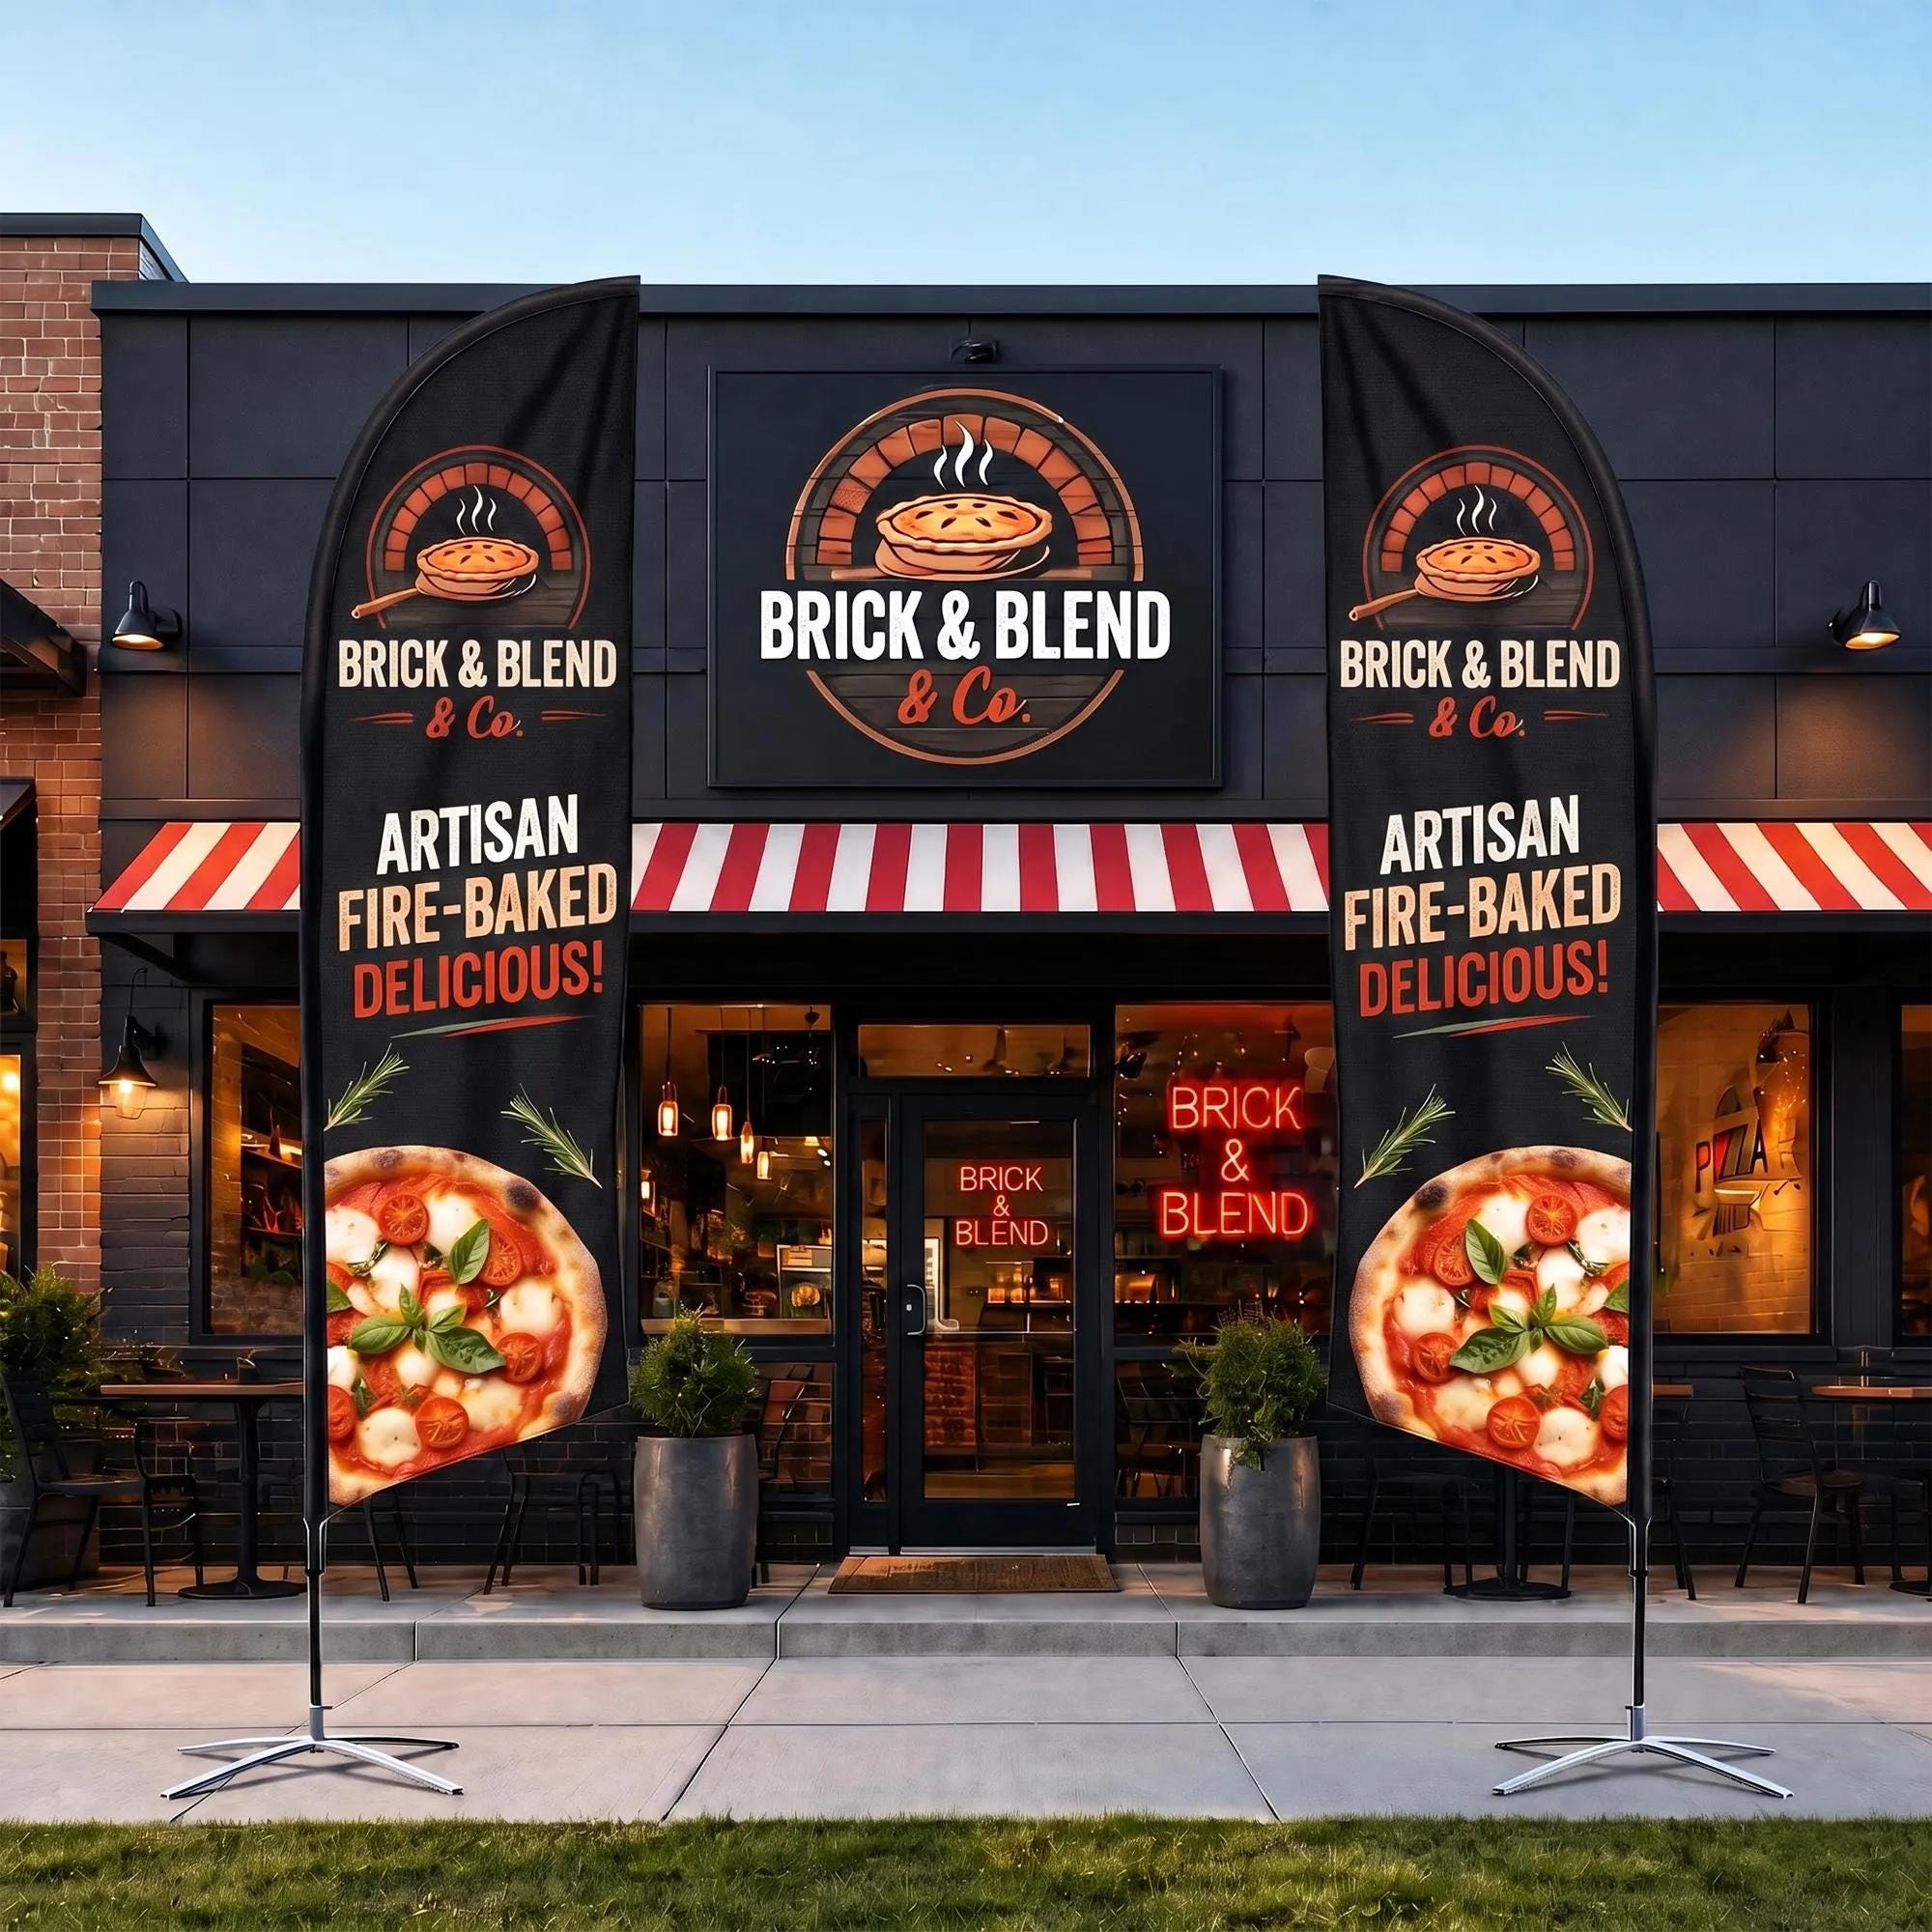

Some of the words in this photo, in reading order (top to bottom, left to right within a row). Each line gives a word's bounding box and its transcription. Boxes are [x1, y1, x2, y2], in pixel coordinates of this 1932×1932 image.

[760, 590, 924, 660] BRICK
[937, 589, 981, 661] &
[995, 590, 1171, 660] BLEND
[338, 639, 449, 688] BRICK
[458, 639, 487, 688] &
[497, 639, 617, 688] BLEND
[1340, 639, 1453, 688] BRICK
[1462, 639, 1492, 688] &
[1500, 639, 1621, 688] BLEND
[426, 696, 456, 739] &
[467, 696, 525, 739] Co.
[897, 668, 938, 724] &
[952, 666, 1031, 724] Co.
[1428, 696, 1459, 738] &
[1468, 696, 1525, 738] Co.
[376, 794, 579, 875] ARTISAN
[1379, 794, 1579, 875] ARTISAN
[338, 863, 617, 952] FIRE-BAKED
[1345, 863, 1622, 952] FIRE-BAKED
[354, 940, 603, 1018] DELICIOUS!
[1359, 939, 1607, 1017] DELICIOUS!
[1172, 1087, 1301, 1129] BRICK
[959, 1166, 1043, 1191] BRICK
[1220, 1138, 1250, 1182] &
[993, 1195, 1011, 1217] &
[1162, 1191, 1309, 1236] BLEND
[955, 1220, 1049, 1245] BLEND
